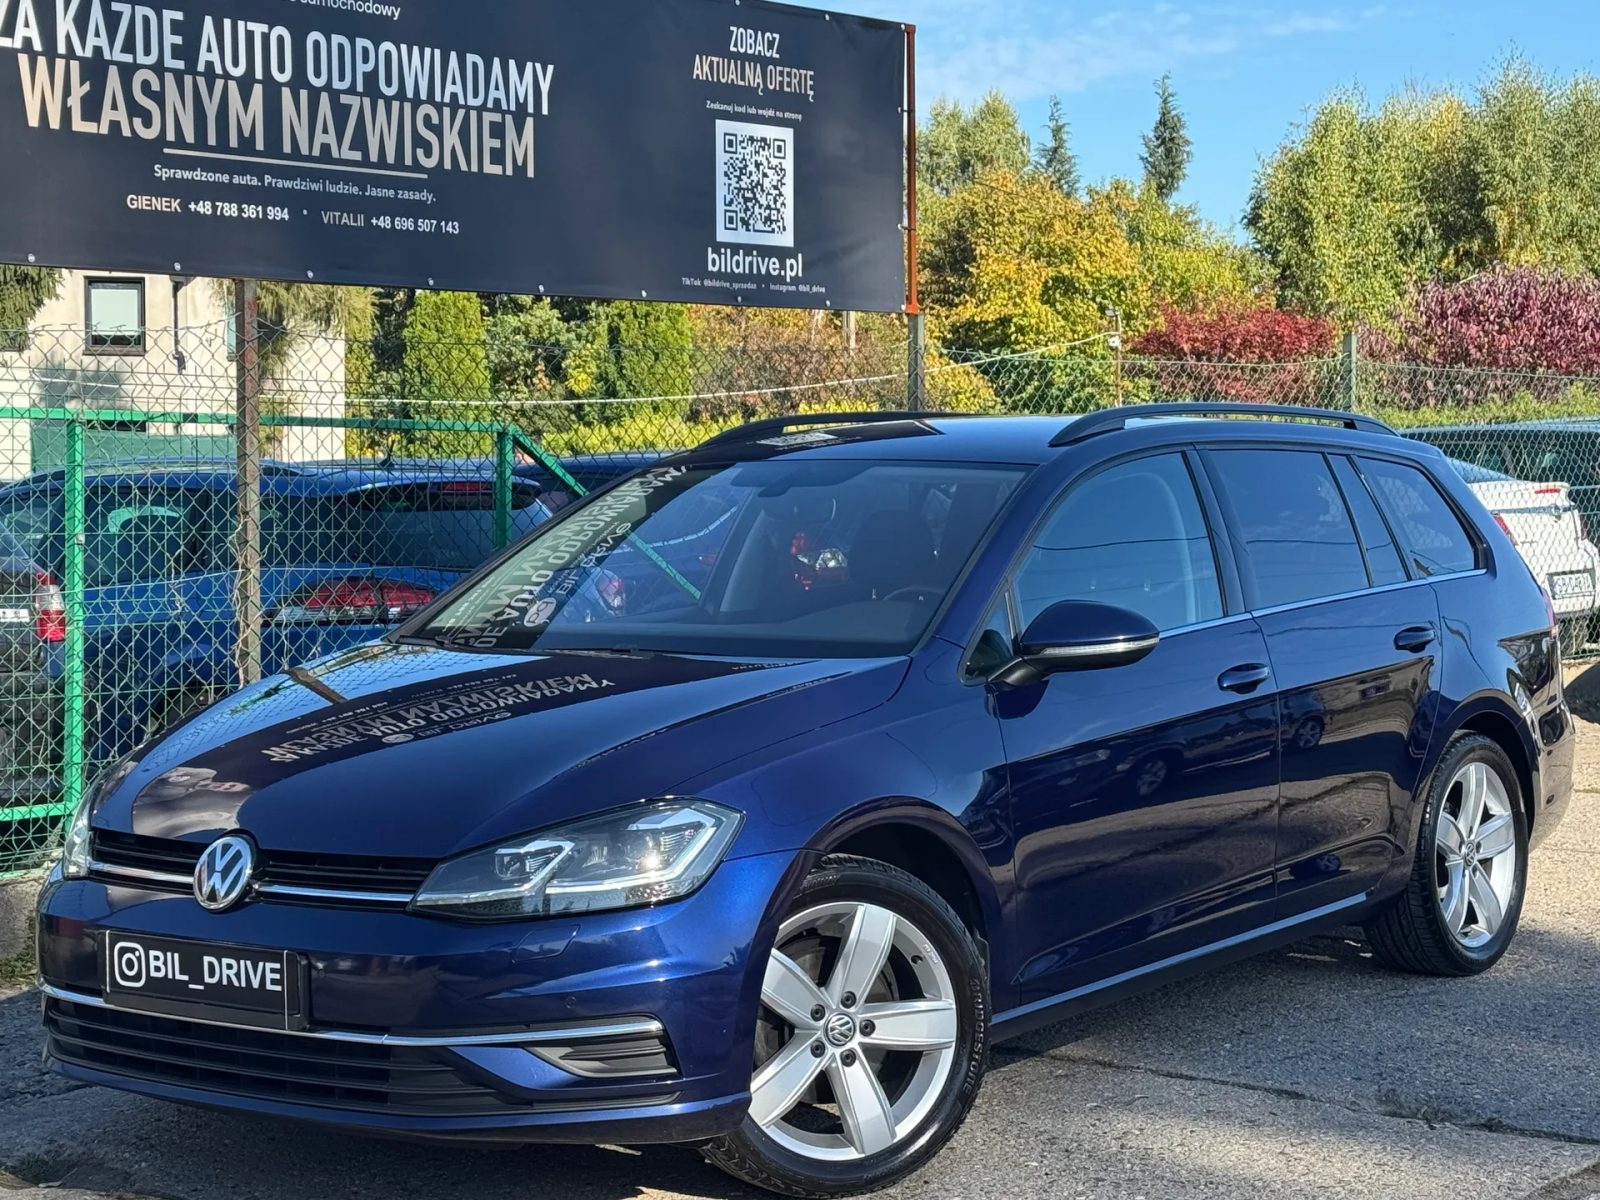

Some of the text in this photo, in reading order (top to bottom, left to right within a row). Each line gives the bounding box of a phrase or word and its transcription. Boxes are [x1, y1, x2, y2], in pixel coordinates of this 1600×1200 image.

[729, 26, 780, 58] ZOBACZ
[196, 15, 293, 83] AUTO
[306, 31, 554, 116] ODPOWIADAMY
[692, 54, 815, 102] AKTUALNĄ OFERTĘ
[17, 53, 535, 179] WŁASNYM NAZWISKIEM
[706, 100, 734, 113] Zeskanuj
[734, 103, 746, 113] kod
[154, 164, 437, 205] Sprawdzone auta. Prawdziwi ludzie. Jasne zasady.
[126, 194, 290, 221] GIENEK +48 788 361 994
[321, 210, 460, 234] VITALII +48 696 507 143
[707, 246, 803, 282] bildrive.pl
[148, 950, 282, 991] BIL_DRIVE
